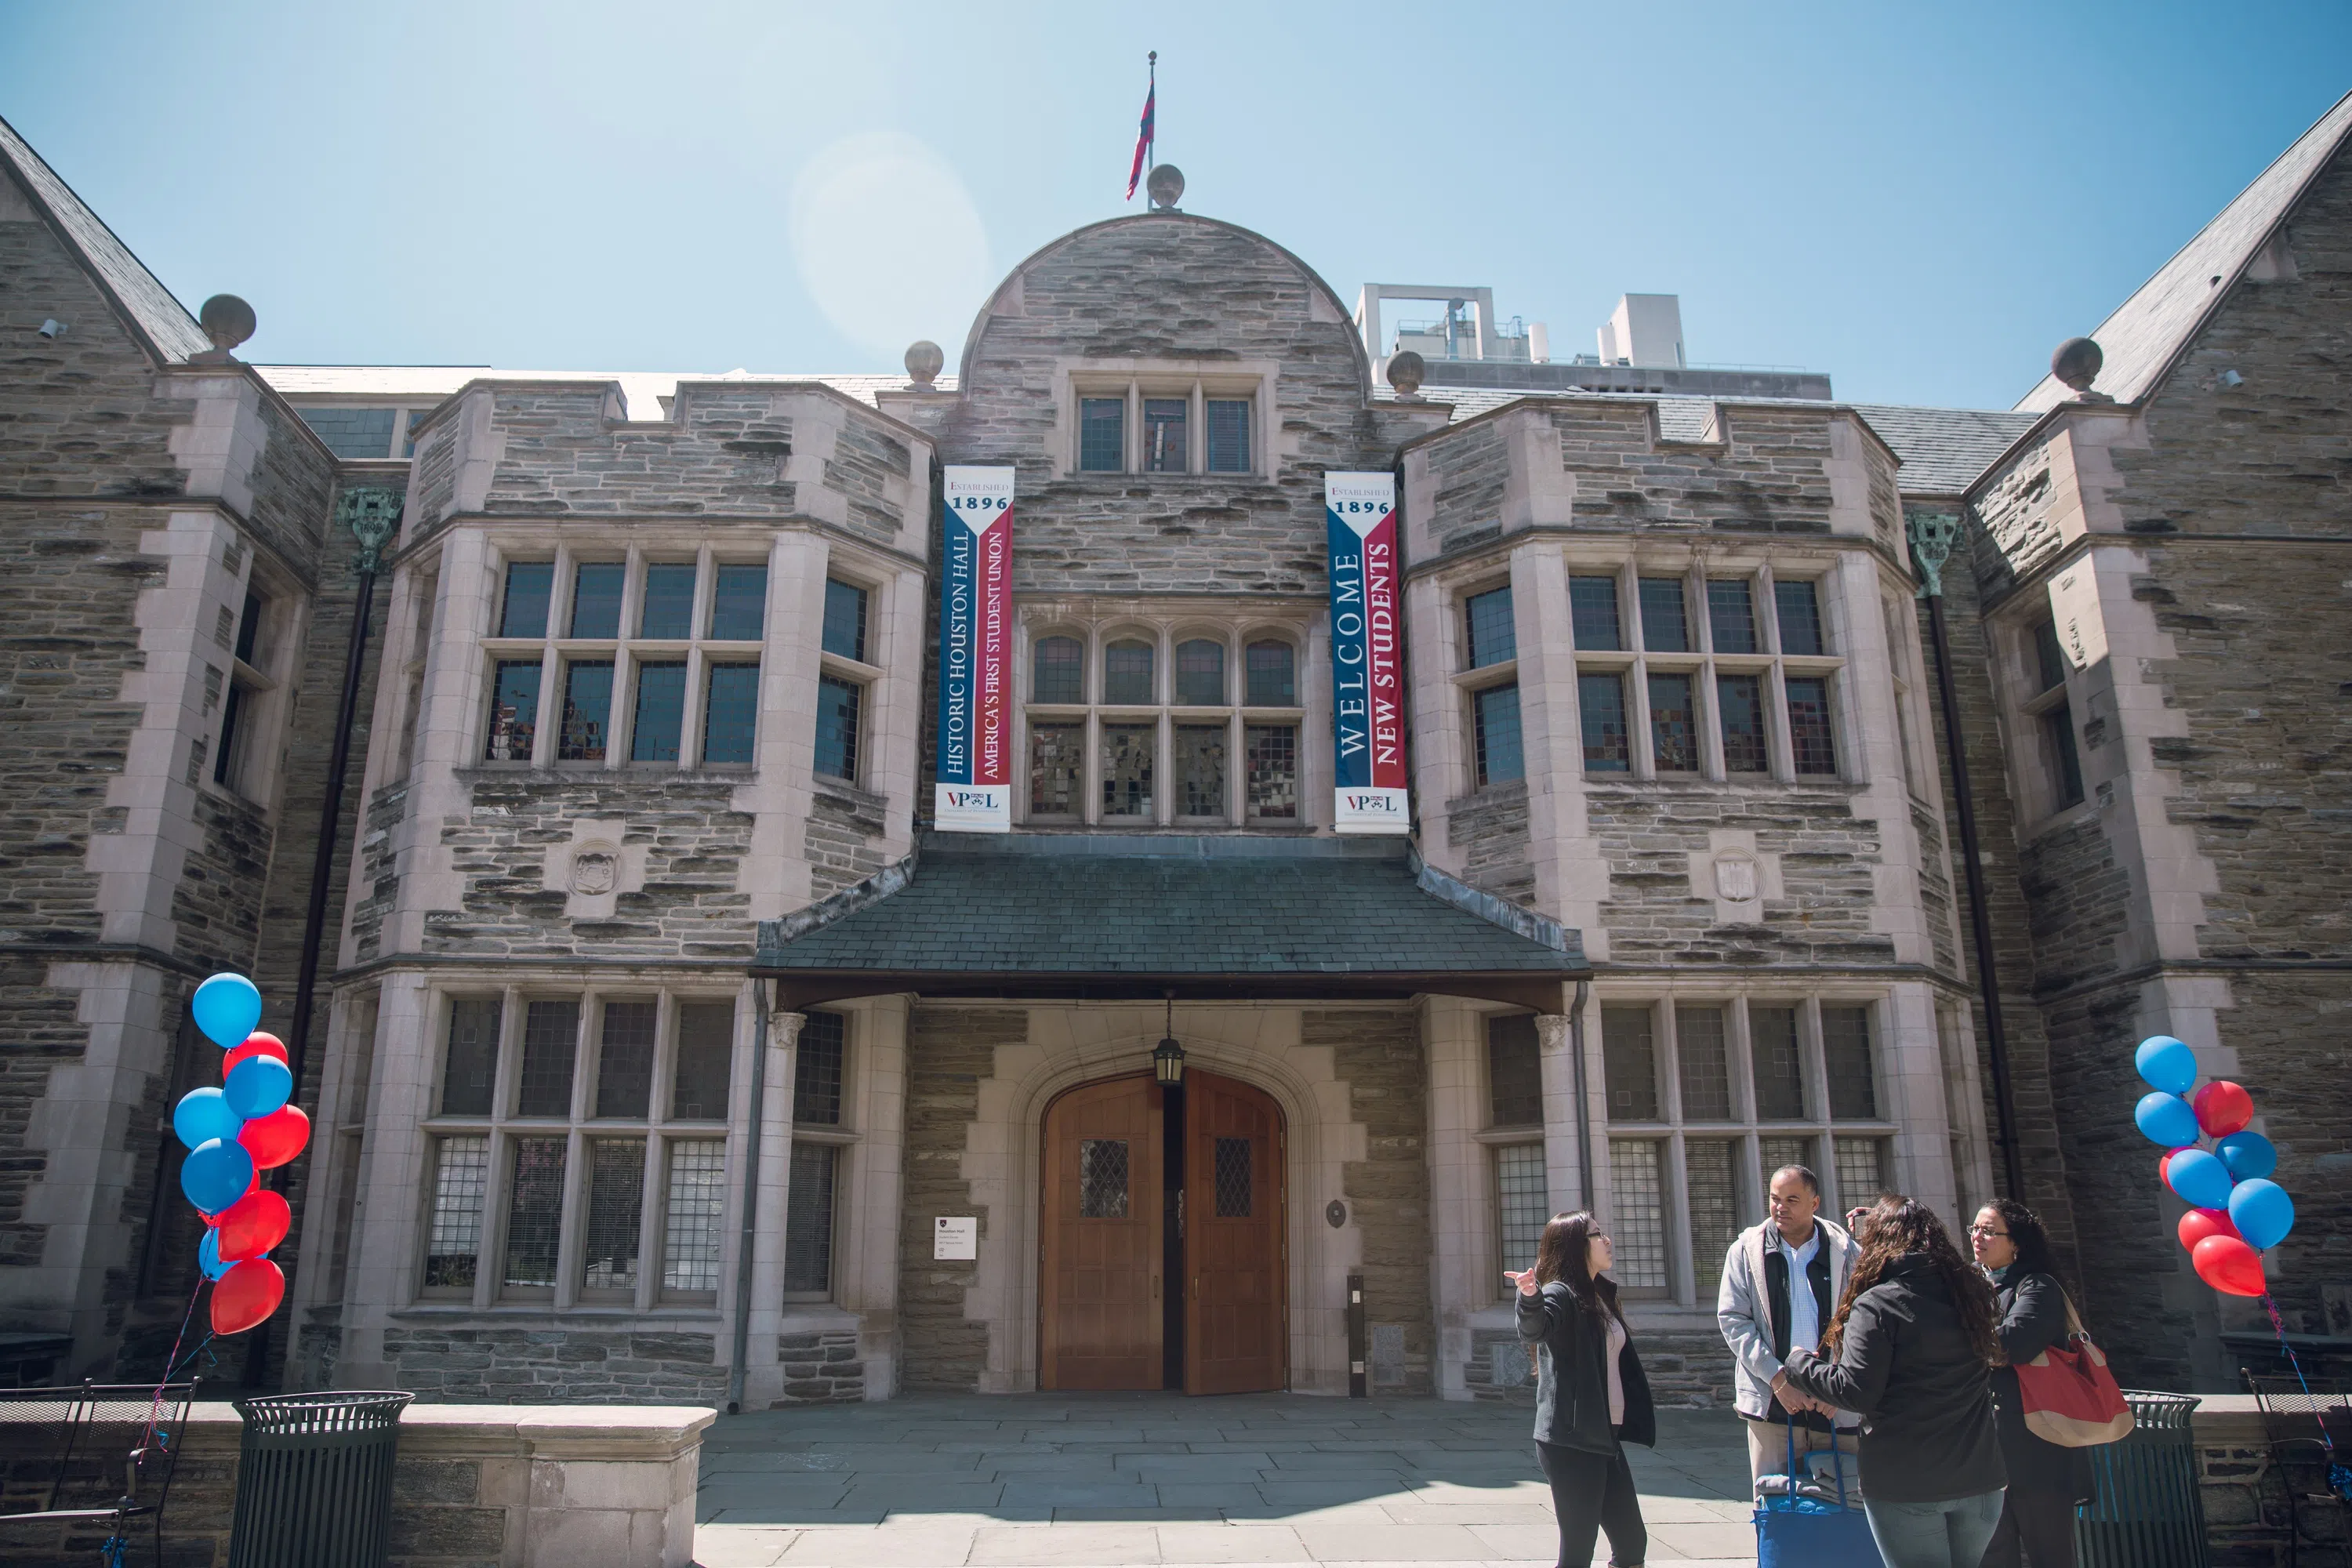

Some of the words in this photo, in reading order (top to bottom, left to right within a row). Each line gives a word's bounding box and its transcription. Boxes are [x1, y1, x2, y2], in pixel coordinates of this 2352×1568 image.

[950, 481, 1009, 491] ESTABLISHED
[953, 496, 1007, 510] 1896
[1332, 488, 1390, 496] ESTABLISHED
[1335, 501, 1389, 514] 1896
[953, 531, 968, 578] HALL
[989, 532, 1002, 581] UNION
[950, 583, 967, 679] HOUSTON
[986, 584, 1000, 652] STUDENT
[1368, 543, 1395, 688] STUDENTS
[985, 656, 1000, 693] FIRST
[1335, 554, 1366, 758] WELCOME
[948, 684, 965, 775] HISTORIC
[984, 695, 999, 779] AMERICA'S
[1375, 696, 1397, 765] NEW
